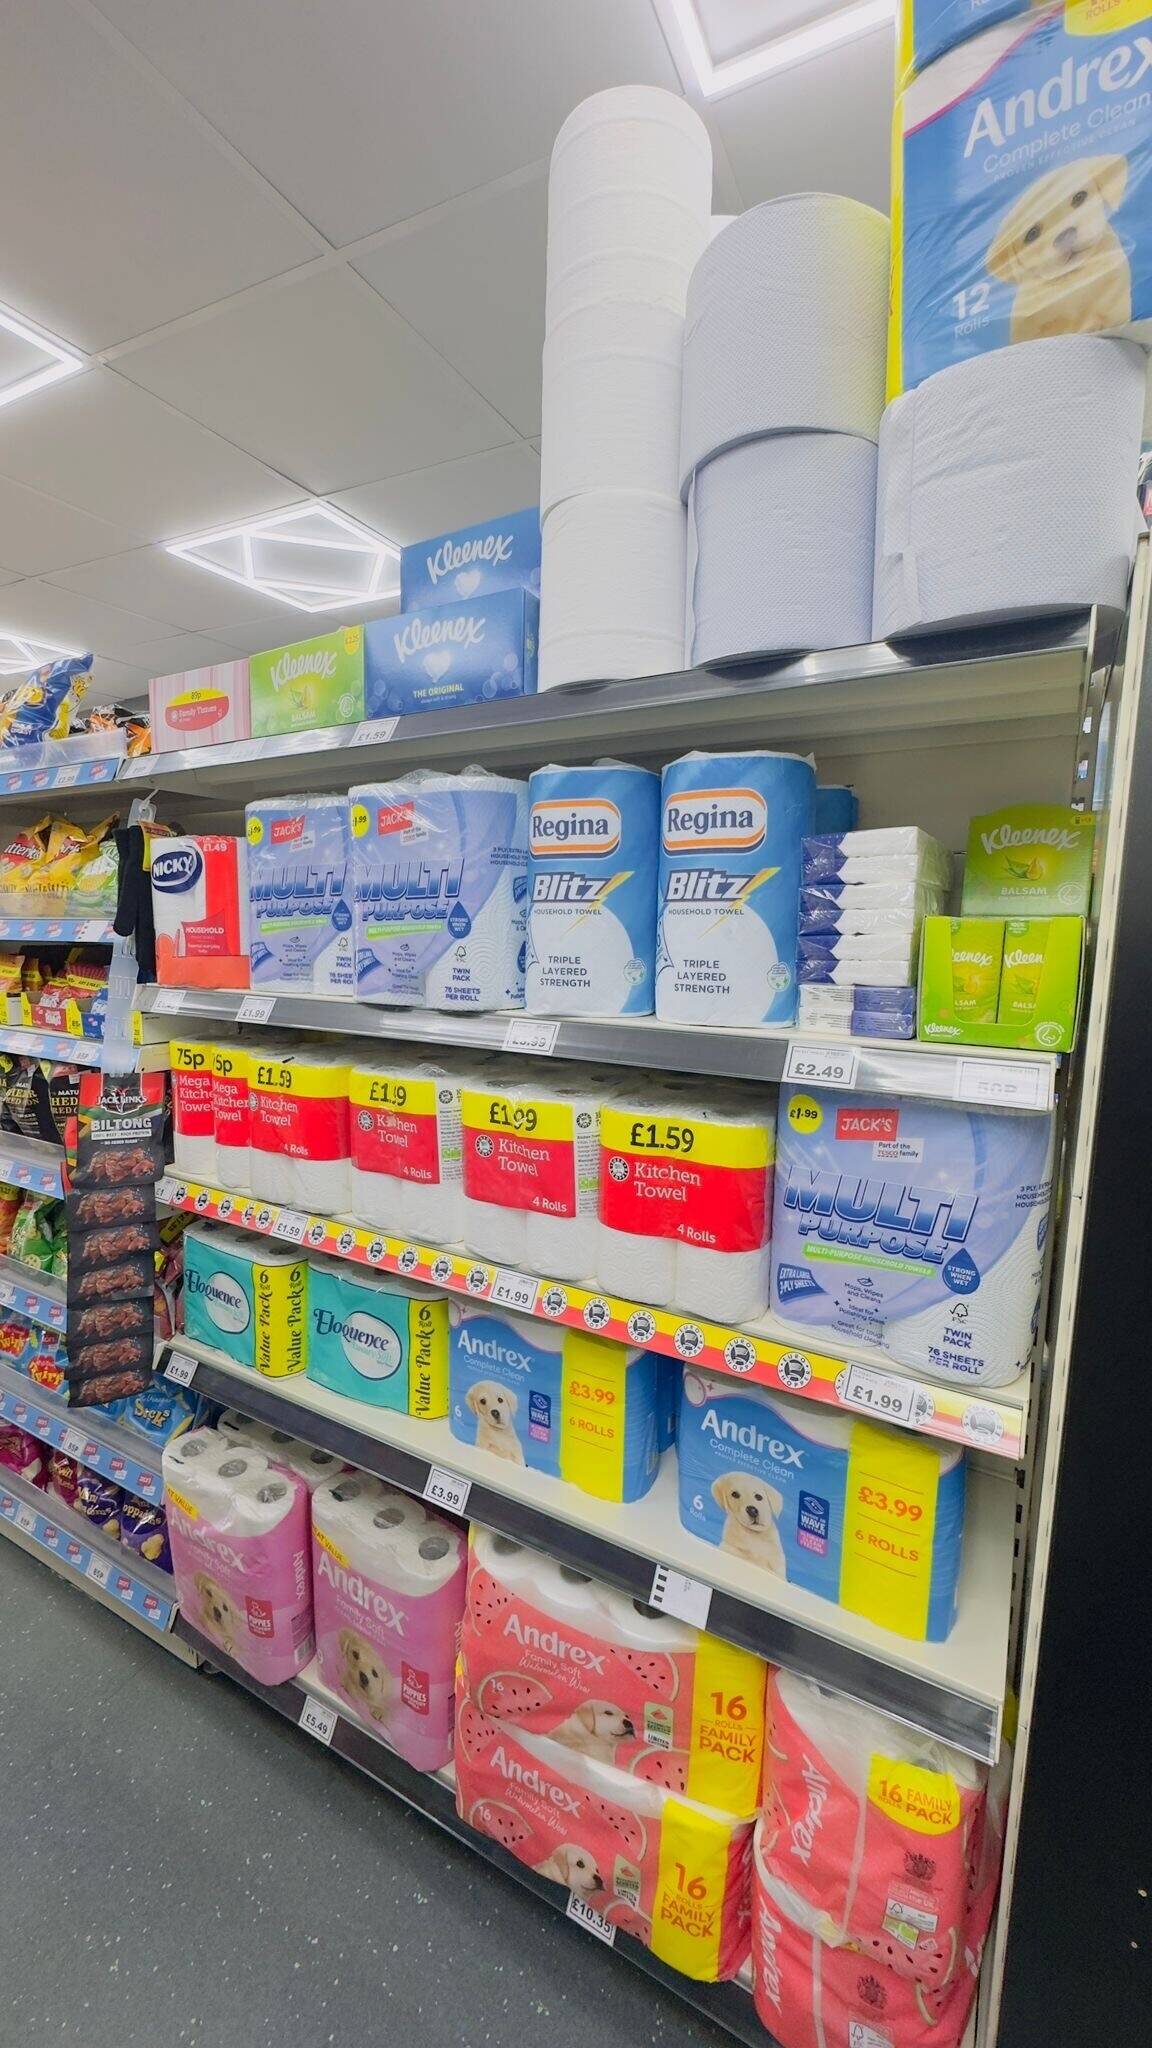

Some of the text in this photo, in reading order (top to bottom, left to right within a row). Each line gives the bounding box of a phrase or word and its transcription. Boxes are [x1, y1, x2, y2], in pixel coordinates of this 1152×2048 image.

[963, 37, 1152, 159] Andrex
[983, 92, 1150, 173] Complete Clean
[952, 283, 991, 320] 12
[954, 316, 990, 340] Rolls
[426, 534, 514, 584] Kleenex
[393, 610, 487, 664] Kleenex
[270, 649, 338, 691] Kleenex
[413, 689, 427, 699] THE
[429, 683, 464, 696] ORIGINAL
[358, 730, 387, 742] £1.59
[532, 813, 609, 841] Regina
[667, 804, 754, 834] Regina
[203, 843, 228, 852] £1.49
[981, 823, 1082, 856] Kleenex
[153, 855, 193, 877] NICKY
[250, 862, 348, 902] MULTI
[354, 857, 465, 902] MULTI
[533, 872, 607, 901] Blitz
[667, 868, 750, 900] Blitz
[1001, 886, 1047, 897] BALSAM
[361, 900, 450, 921] PURPOSE
[533, 908, 603, 916] HOUSEHOLD TOWEL
[668, 908, 745, 916] HOUSEHOLD TOWEL
[548, 955, 582, 965] TRIPLE
[683, 959, 720, 969] TRIPLE
[452, 967, 471, 975] TWIN
[542, 967, 588, 977] LAYERED
[677, 971, 727, 982] LAYERED
[454, 986, 481, 995] SHEETS
[540, 978, 591, 988] STRENGTH
[674, 983, 731, 995] STRENGTH
[243, 1008, 266, 1018] £1.99
[924, 1023, 963, 1036] Kleenex
[177, 1048, 205, 1070] 75p
[180, 1074, 211, 1088] Mega
[258, 1066, 292, 1088] £1.59
[794, 1062, 845, 1079] £2.49
[213, 1081, 238, 1095] Mega
[97, 1096, 119, 1105] JACK
[180, 1101, 215, 1112] Towel
[260, 1095, 298, 1114] Kitchen
[91, 1117, 152, 1131] BILTONG
[214, 1108, 242, 1121] Towel
[261, 1110, 291, 1126] Towel
[789, 1108, 818, 1119] £1.99
[841, 1118, 893, 1132] JACK'S
[378, 1129, 409, 1148] Towel
[630, 1122, 695, 1153] £1.59
[498, 1138, 550, 1161] Kitchen
[403, 1166, 432, 1180] 4 Rolls
[498, 1156, 539, 1177] Towel
[634, 1162, 701, 1187] Kitchen
[634, 1181, 688, 1202] Towel
[532, 1197, 568, 1213] 4 Rolls
[783, 1165, 979, 1242] MULTI
[276, 1221, 300, 1237] £1.59
[677, 1223, 717, 1244] 4 Rolls
[798, 1214, 950, 1264] PURPOSE
[260, 1270, 269, 1284] 6
[289, 1266, 301, 1282] 6
[947, 1265, 976, 1276] STRONG
[950, 1272, 972, 1281] WHEN
[185, 1268, 242, 1309] Eloquence
[953, 1278, 969, 1287] WET
[496, 1286, 530, 1304] £1.99
[418, 1304, 431, 1321] 6
[258, 1291, 273, 1372] Value Pack
[287, 1286, 304, 1372] Value Pack
[313, 1308, 390, 1351] Eloquence
[944, 1326, 973, 1341] TWIN
[457, 1329, 532, 1373] Andrex
[943, 1336, 972, 1349] PACK
[928, 1346, 984, 1367] 76 SHEETS
[928, 1355, 981, 1376] PER ROLL
[168, 1363, 189, 1380] £1.99
[415, 1328, 435, 1416] Value Pack
[463, 1354, 525, 1383] Complete Clean
[569, 1381, 615, 1405] £3.99
[853, 1384, 904, 1414] £1.99
[454, 1405, 462, 1417] 6
[569, 1417, 614, 1438] 6 ROLLS
[701, 1409, 804, 1469] Andrex
[709, 1438, 795, 1479] Complete Clean
[430, 1484, 460, 1505] £3.99
[692, 1494, 704, 1510] 6
[857, 1486, 923, 1522] £3.99
[800, 1514, 826, 1532] WAVE
[171, 1507, 246, 1574] Andrex
[855, 1530, 919, 1562] 6 ROLLS
[293, 1549, 306, 1600] Andrex
[318, 1551, 407, 1637] Andrex
[502, 1614, 607, 1676] Andrex
[525, 1649, 558, 1670] Family
[490, 1678, 505, 1692] 16
[710, 1691, 748, 1721] 16
[305, 1712, 329, 1735] £5.49
[714, 1719, 744, 1731] ROLLS
[699, 1724, 757, 1747] FAMILY
[699, 1736, 756, 1763] PACK
[490, 1745, 584, 1818] Andrex
[878, 1780, 903, 1803] 16
[906, 1788, 953, 1812] FAMILY
[478, 1805, 492, 1822] 16
[906, 1803, 953, 1825] PACK
[675, 1862, 707, 1900] 16
[572, 1898, 611, 1935] £10.35
[662, 1892, 715, 1923] FAMILY
[660, 1907, 714, 1939] PACK
